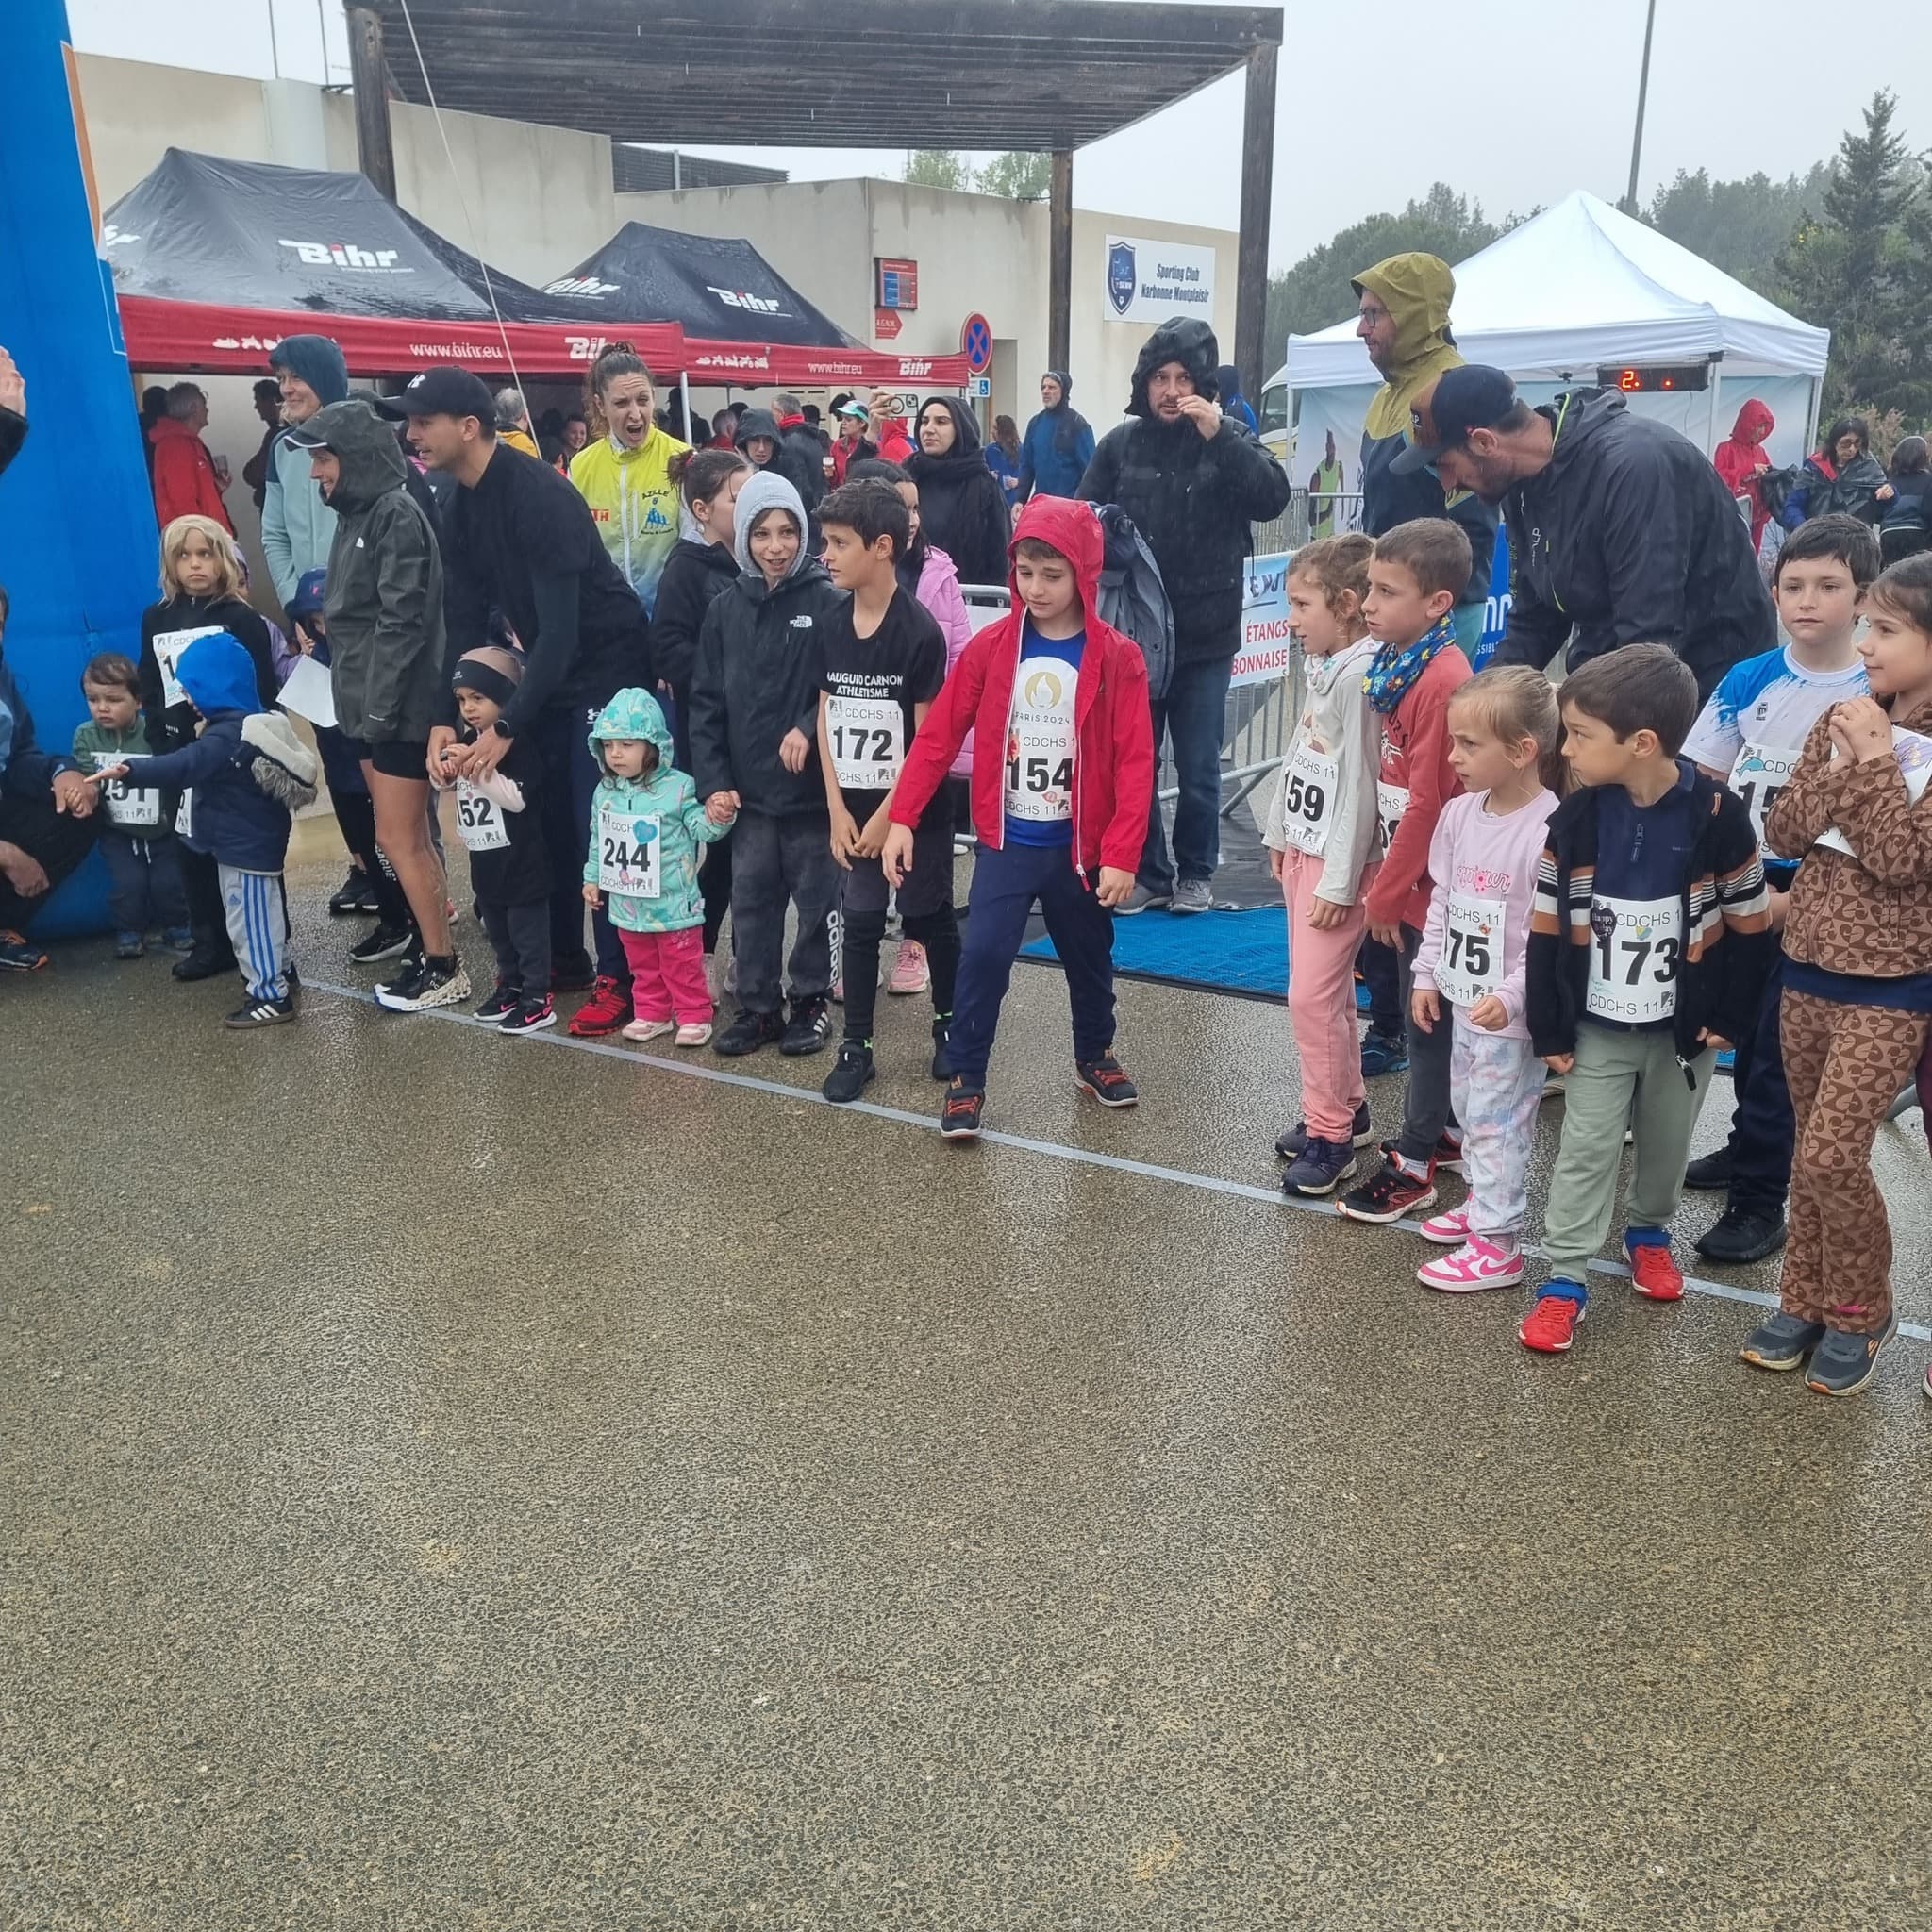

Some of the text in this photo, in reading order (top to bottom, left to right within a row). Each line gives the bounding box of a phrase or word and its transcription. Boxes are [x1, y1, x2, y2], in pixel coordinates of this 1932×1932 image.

[278, 239, 398, 267] Bihr
[1157, 263, 1200, 282] Sporting Club
[706, 285, 779, 311] Bihr
[1141, 283, 1173, 300] Narbonne
[1173, 286, 1209, 303] Montplaisir
[409, 341, 503, 358] www.bihr.eu
[565, 337, 606, 359] Bi
[898, 358, 932, 375] Bihr
[1246, 619, 1289, 643] ÉTANGS
[1476, 641, 1499, 655] SSIBL
[865, 675, 904, 687] CARNON
[836, 685, 890, 698] ATHLETISME
[845, 708, 900, 721] CDCHS 11
[1016, 711, 1070, 724] PARIS 2024
[833, 725, 893, 761] 172
[1023, 736, 1067, 748] CDCHS
[1006, 756, 1074, 793] 154
[1764, 759, 1797, 775] CDC
[836, 770, 861, 783] CHS
[612, 822, 635, 833] CDCH
[603, 837, 651, 873] 244
[1486, 913, 1500, 925] 11
[1616, 910, 1671, 928] CDCHS
[1596, 937, 1679, 984] 173
[1590, 993, 1659, 1015] CDCHS 11
